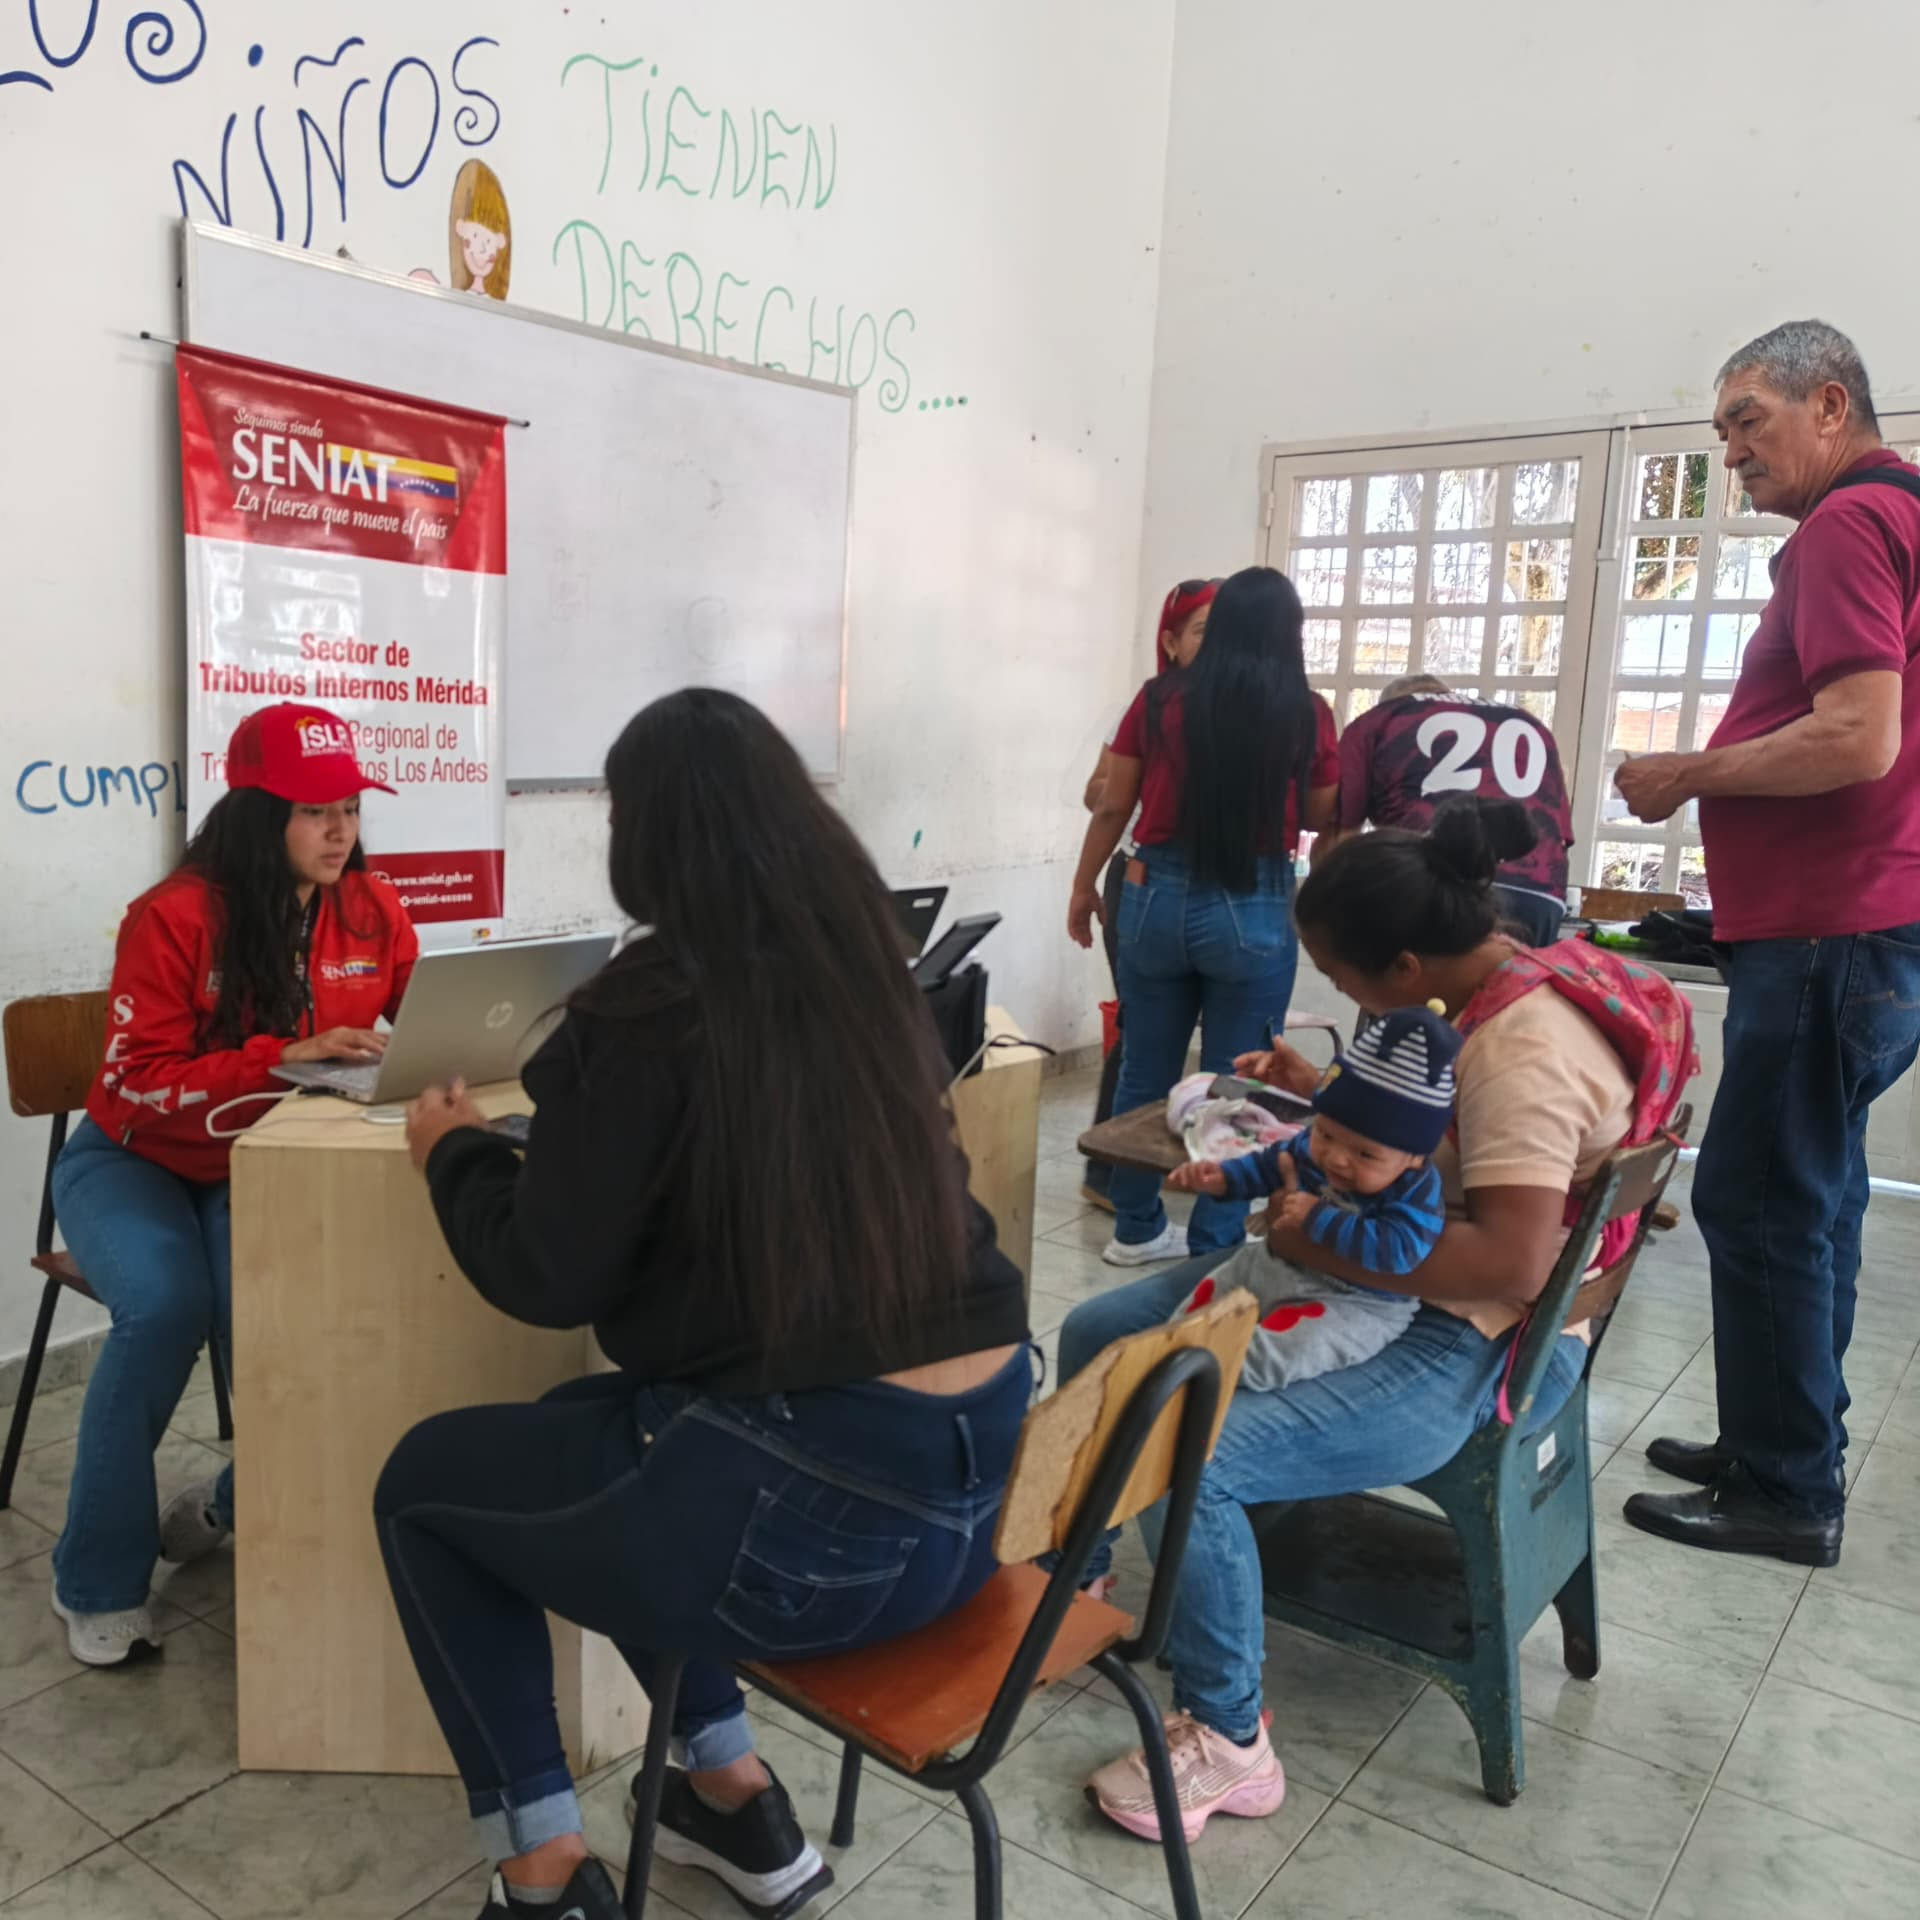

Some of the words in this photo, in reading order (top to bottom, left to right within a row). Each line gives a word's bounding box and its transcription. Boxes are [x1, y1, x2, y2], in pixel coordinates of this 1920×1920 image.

[233, 406, 288, 434] Seguimos
[289, 419, 324, 439] siendo
[232, 428, 397, 504] SENIAT
[232, 484, 259, 512] La
[262, 484, 319, 521] fuerza
[322, 505, 350, 536] que
[352, 510, 400, 533] mueve
[401, 507, 420, 536] el
[300, 632, 379, 665] Sector
[385, 640, 410, 668] de
[199, 661, 307, 697] Tributos
[315, 669, 409, 702] Internos
[416, 676, 488, 706] Mérida
[348, 719, 429, 754] Regional
[436, 723, 458, 750] de
[1416, 711, 1548, 798] 20
[395, 755, 427, 783] Los
[431, 755, 489, 783] Andes
